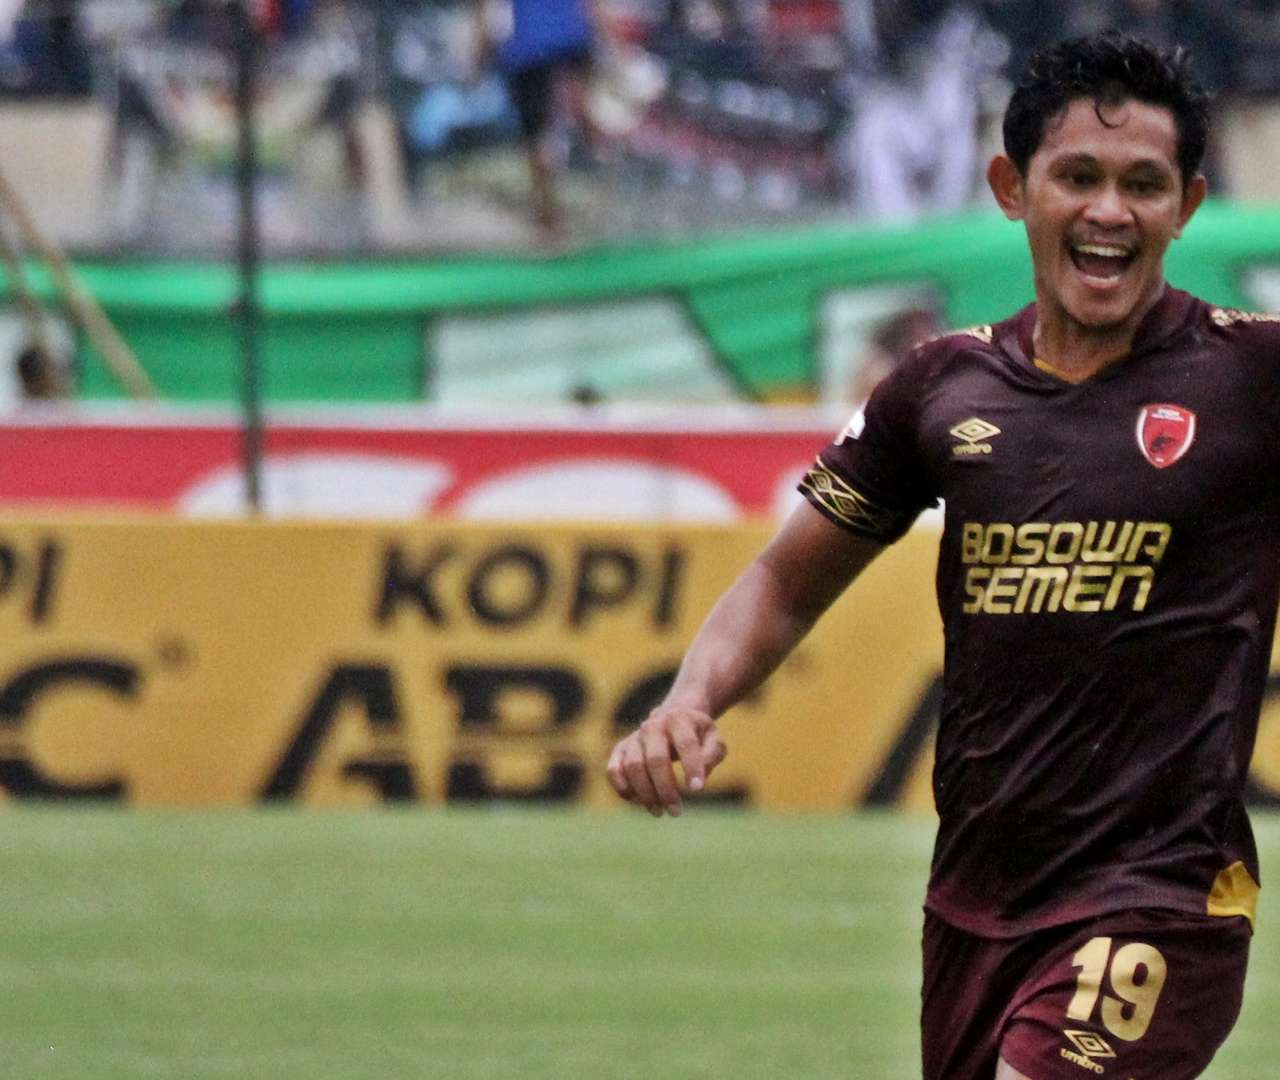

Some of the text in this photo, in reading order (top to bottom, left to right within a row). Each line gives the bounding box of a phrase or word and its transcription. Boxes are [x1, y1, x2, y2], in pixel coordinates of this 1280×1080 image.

[961, 520, 1173, 566] BOSOWA
[370, 541, 688, 630] KOPI
[962, 564, 1156, 615] SEMEN
[1065, 936, 1168, 1042] 19
[1060, 1047, 1105, 1074] umbro
